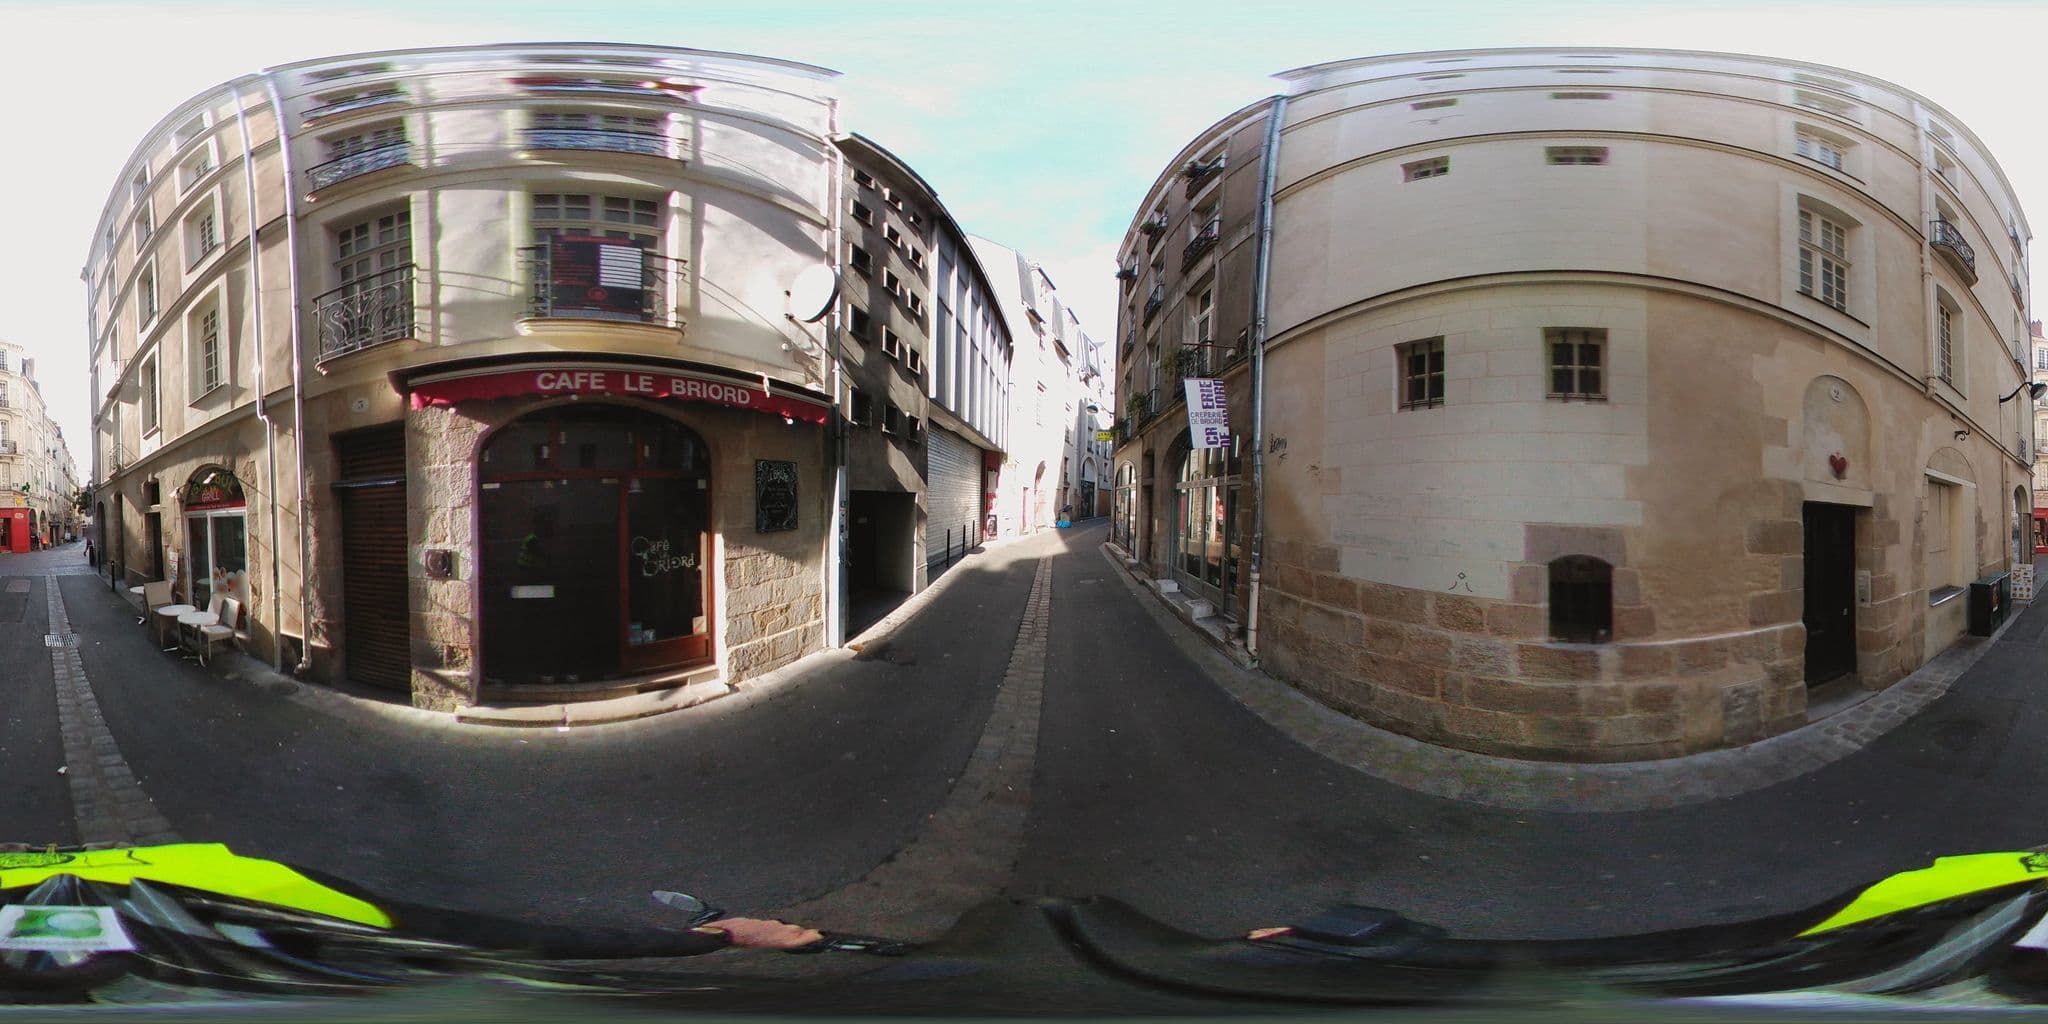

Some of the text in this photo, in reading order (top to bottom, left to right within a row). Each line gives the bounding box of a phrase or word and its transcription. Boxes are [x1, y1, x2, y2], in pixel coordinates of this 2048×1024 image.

[537, 372, 750, 404] CAFE LE BRIORD
